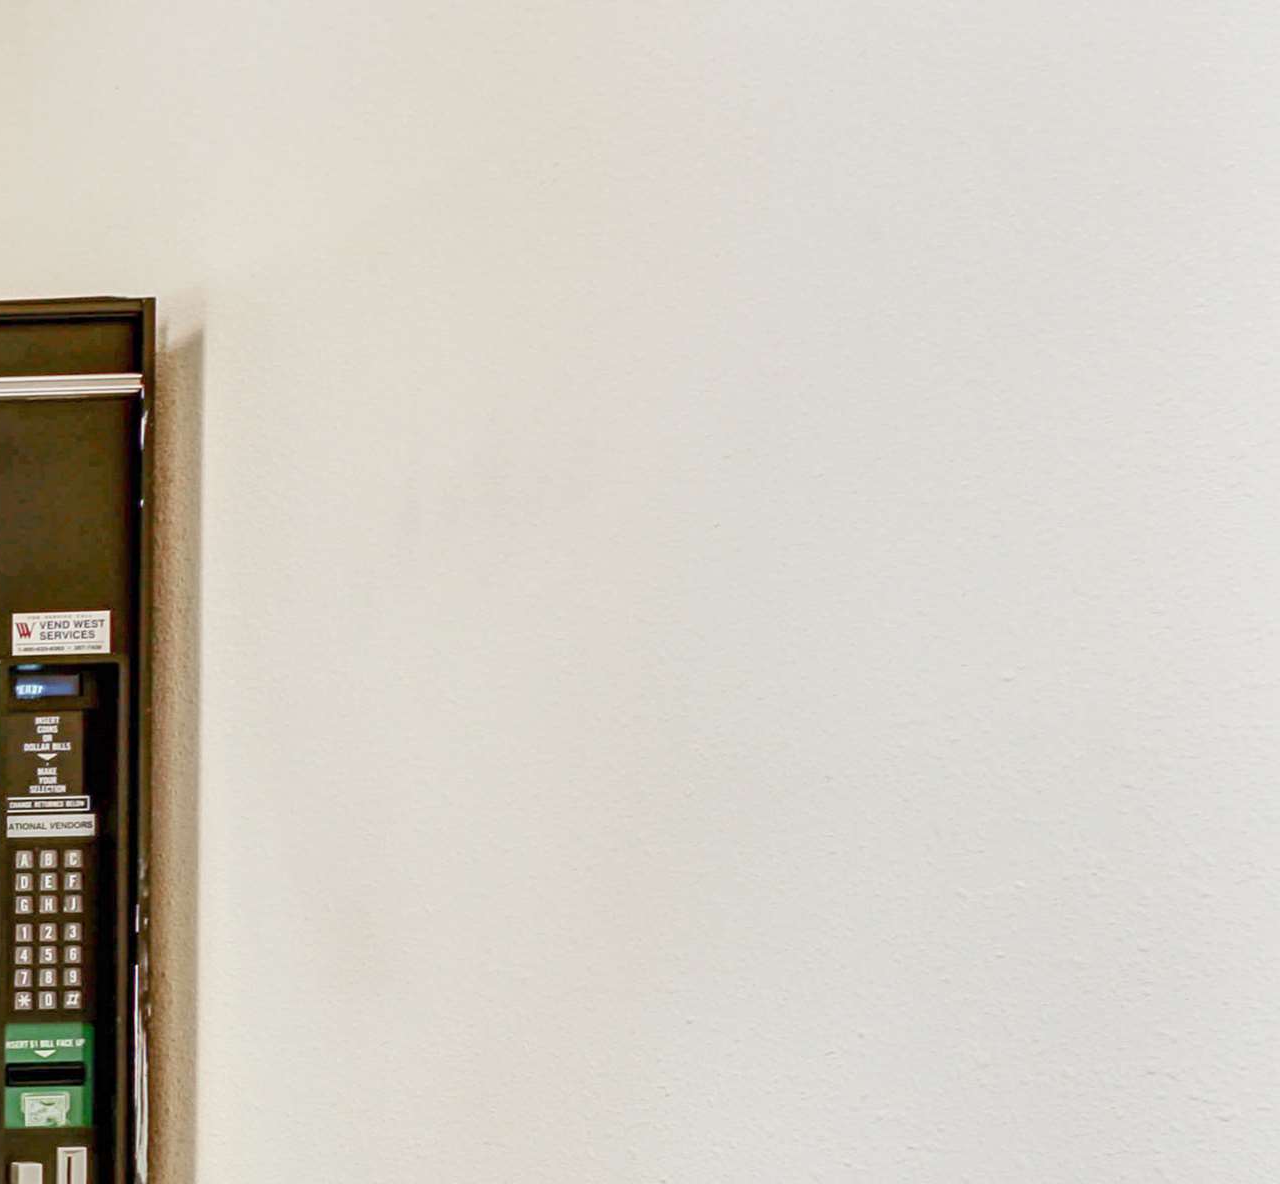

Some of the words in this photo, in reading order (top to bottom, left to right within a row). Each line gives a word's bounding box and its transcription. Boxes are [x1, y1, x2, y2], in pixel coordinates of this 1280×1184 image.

[39, 620, 70, 629] VEND
[73, 619, 105, 628] WEST
[40, 630, 95, 640] SERVICES
[8, 822, 47, 830] ATIONAL
[50, 821, 93, 829] VENDORS
[21, 854, 28, 866] A
[45, 853, 52, 866] B
[70, 853, 77, 865] C
[21, 876, 28, 888] D
[45, 875, 52, 888] E
[69, 875, 77, 888] F
[21, 900, 28, 911] G
[45, 899, 52, 911] H
[71, 897, 75, 910] J
[23, 927, 26, 939] 1
[45, 926, 52, 939] 2
[70, 925, 76, 938] 3
[20, 949, 27, 961] 4
[45, 948, 52, 961] 5
[70, 948, 77, 961] 6
[21, 972, 27, 984] 7
[45, 971, 52, 984] 8
[70, 970, 77, 983] 9
